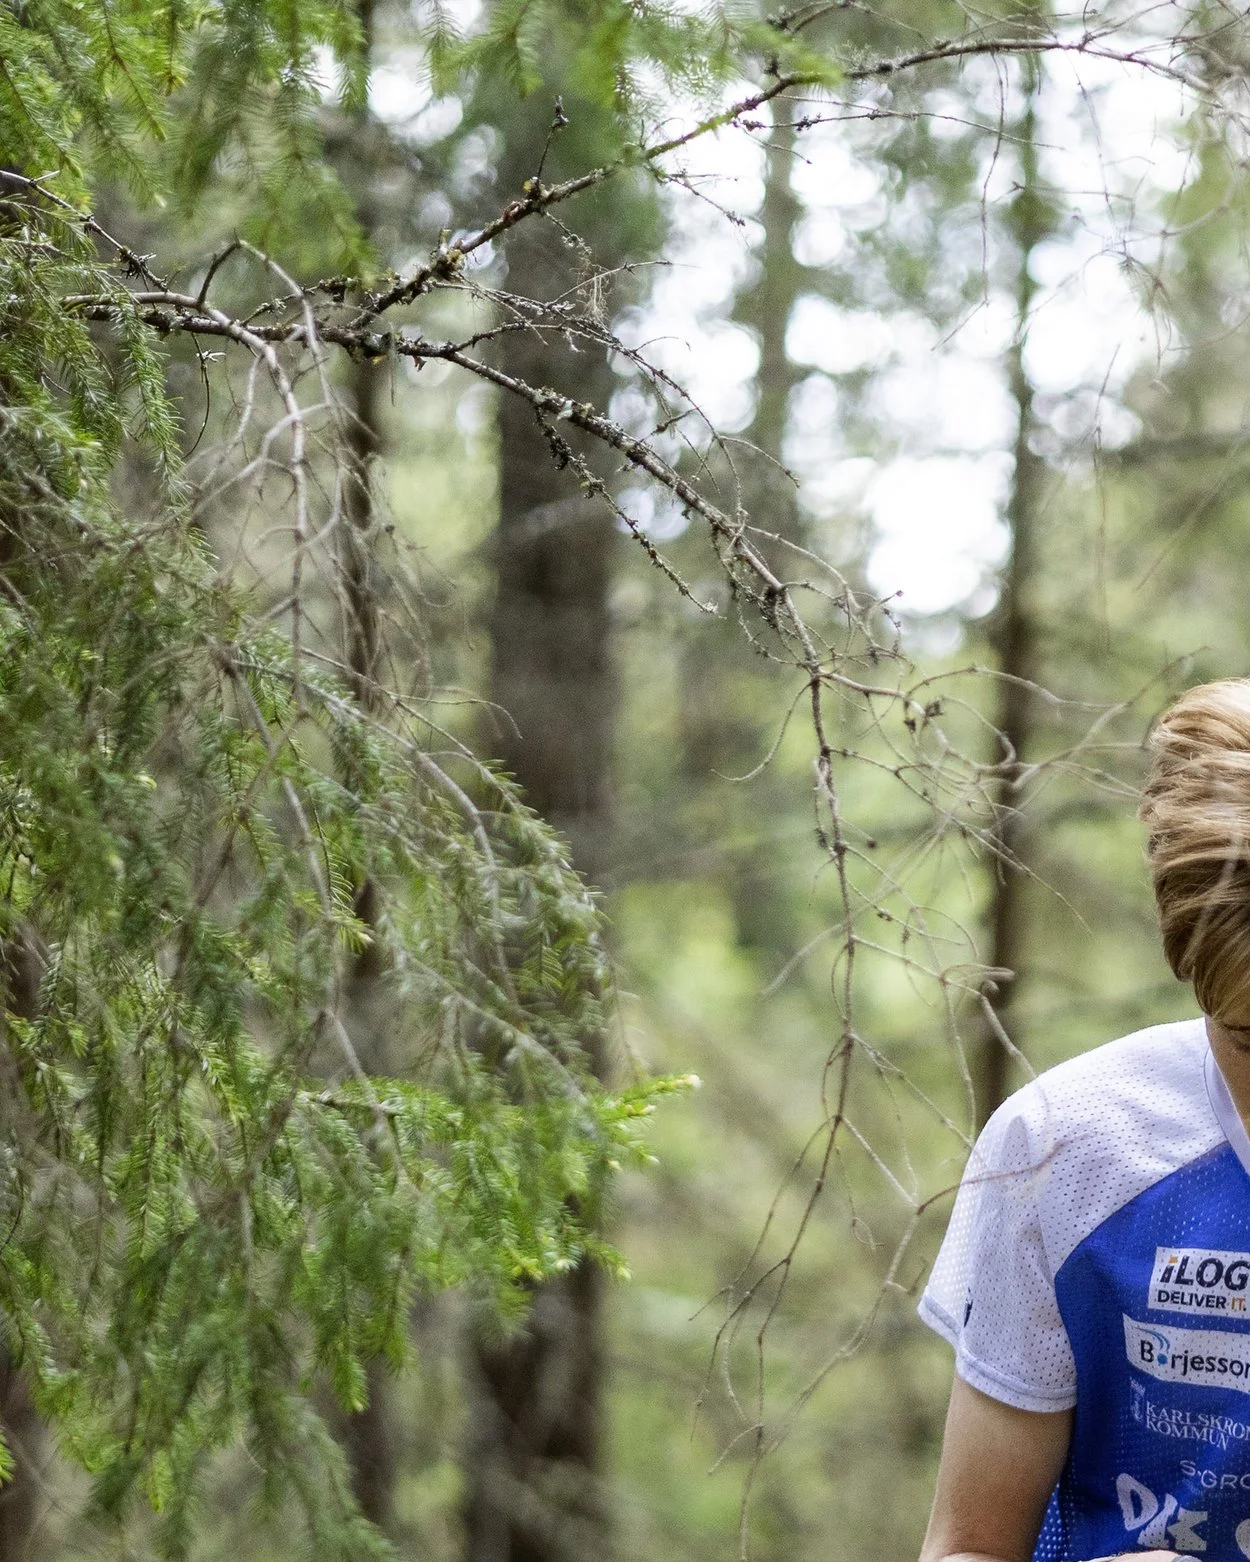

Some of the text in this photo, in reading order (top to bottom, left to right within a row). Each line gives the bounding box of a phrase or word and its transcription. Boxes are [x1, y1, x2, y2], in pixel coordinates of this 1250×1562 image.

[1160, 1256, 1250, 1291] iLOG
[1157, 1290, 1227, 1309] DELIVER
[1146, 1416, 1229, 1451] KOMMUN
